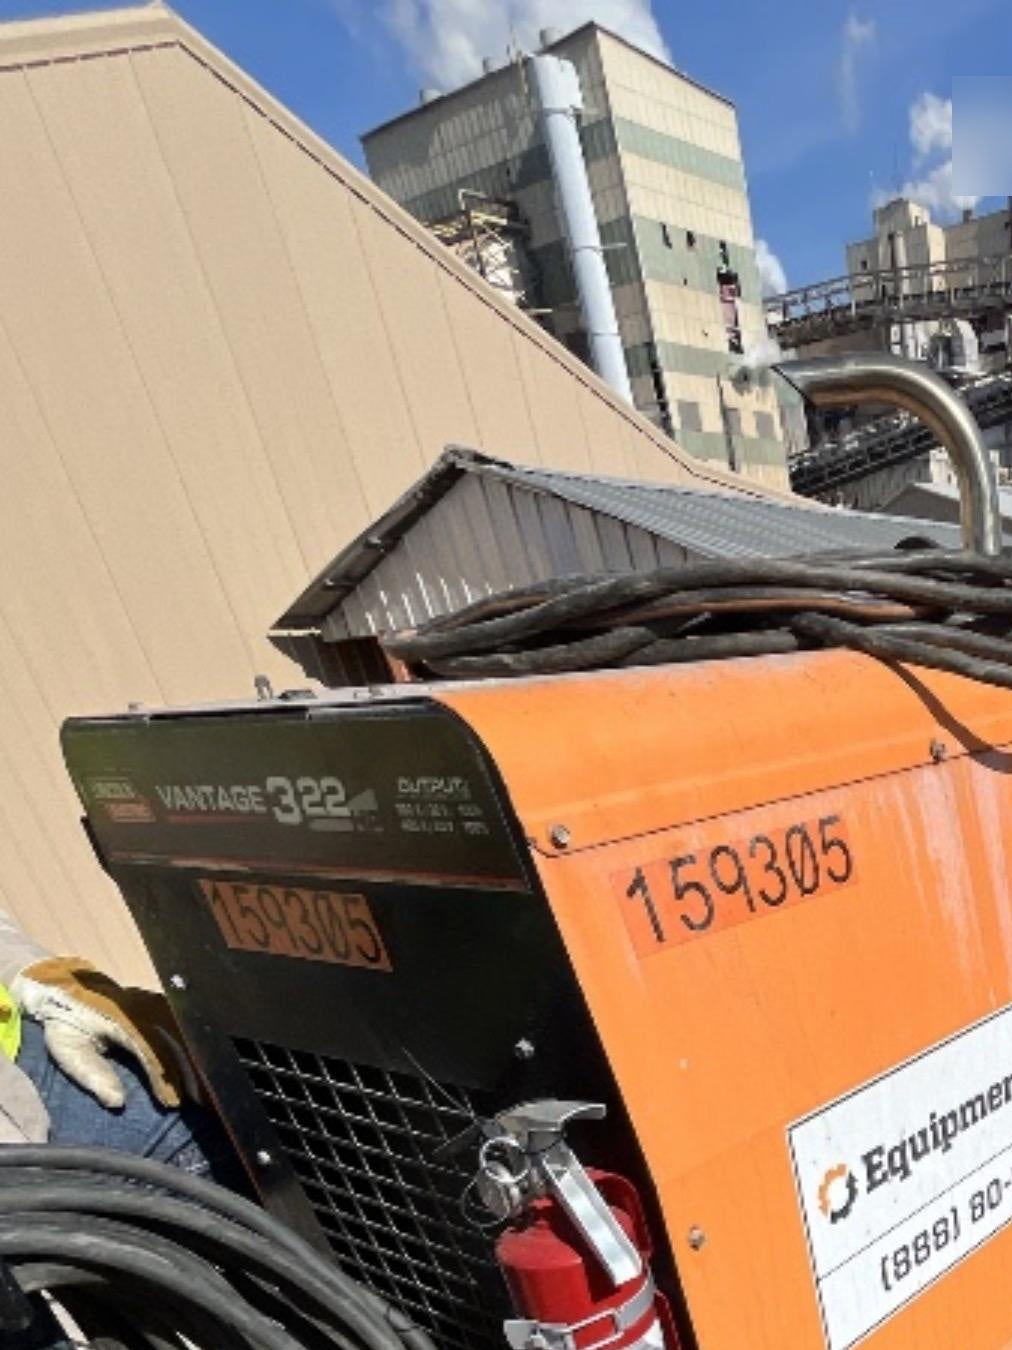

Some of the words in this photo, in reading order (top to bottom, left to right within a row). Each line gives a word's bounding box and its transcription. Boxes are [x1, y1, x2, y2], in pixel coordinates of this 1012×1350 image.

[155, 784, 268, 812] VANTAGE
[265, 776, 352, 825] 322
[625, 815, 854, 943] 159305
[211, 882, 382, 964] 159305
[879, 1206, 960, 1292] (888)
